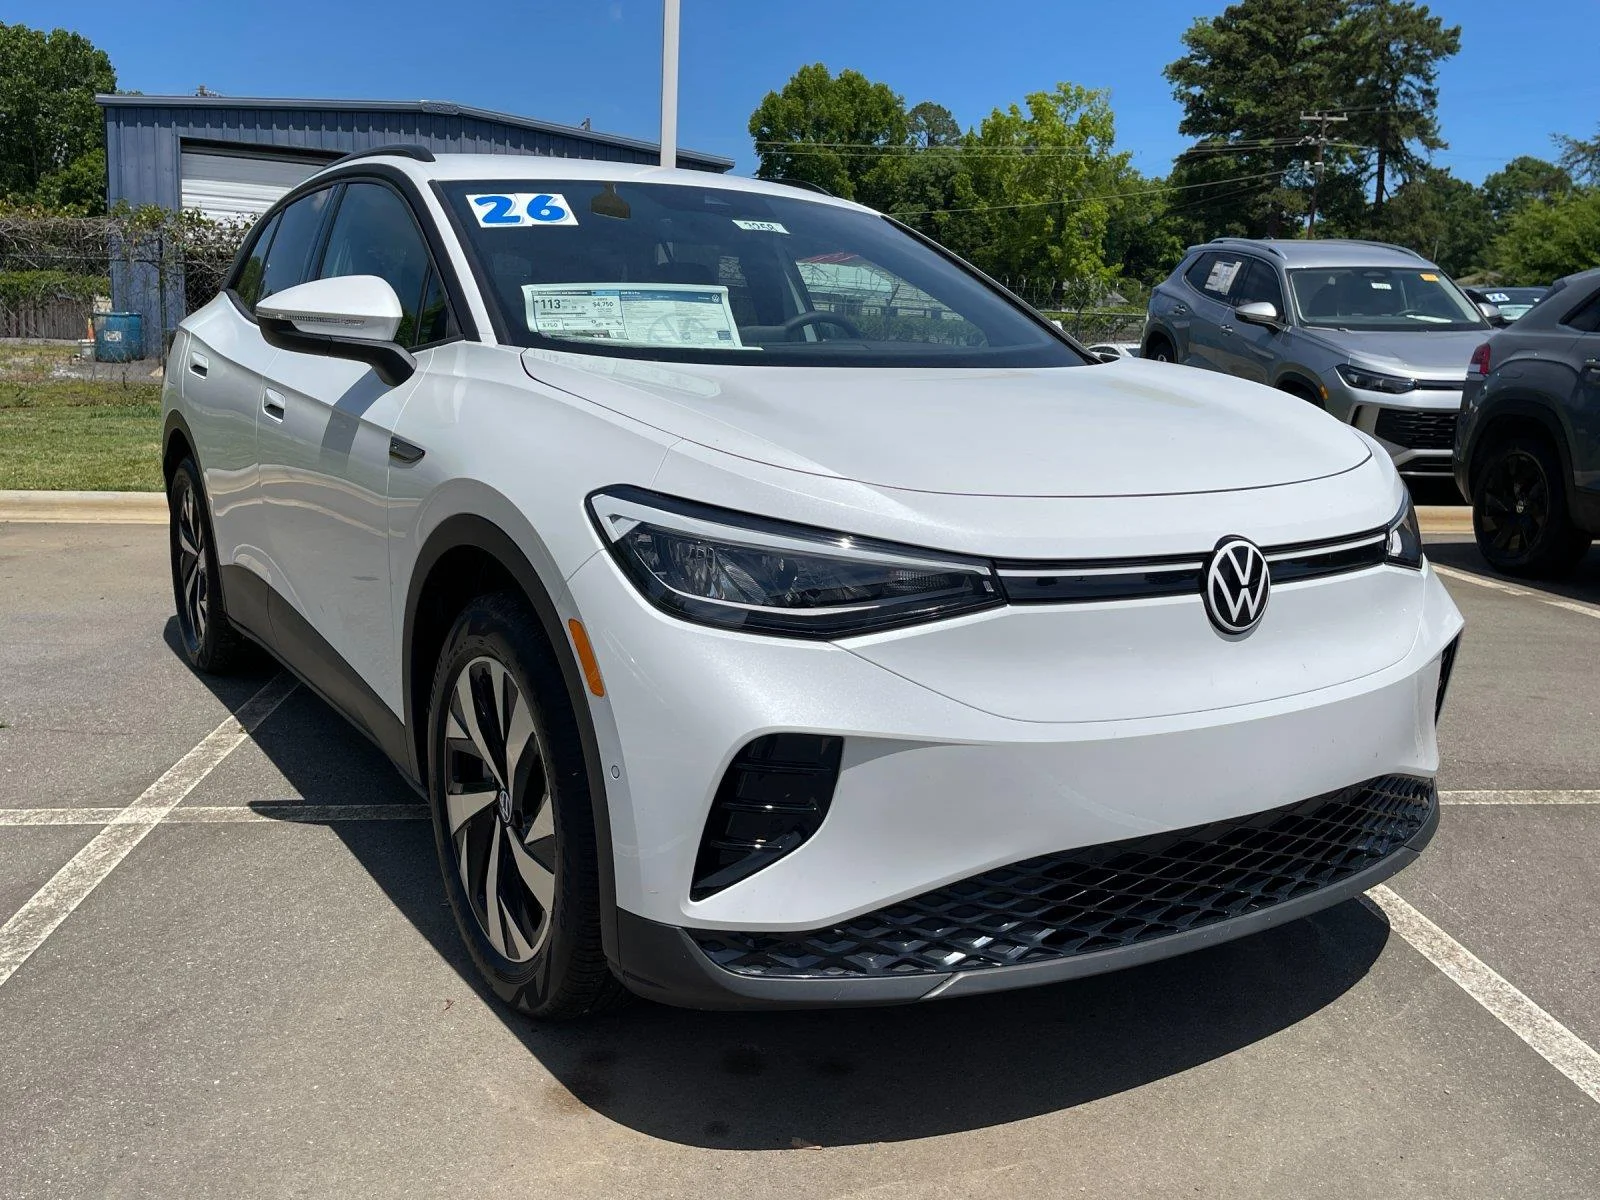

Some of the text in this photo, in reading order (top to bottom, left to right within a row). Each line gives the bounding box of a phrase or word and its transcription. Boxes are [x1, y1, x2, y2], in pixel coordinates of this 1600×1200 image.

[474, 195, 567, 224] 26
[540, 299, 561, 309] 113
[1209, 543, 1269, 628] VW
